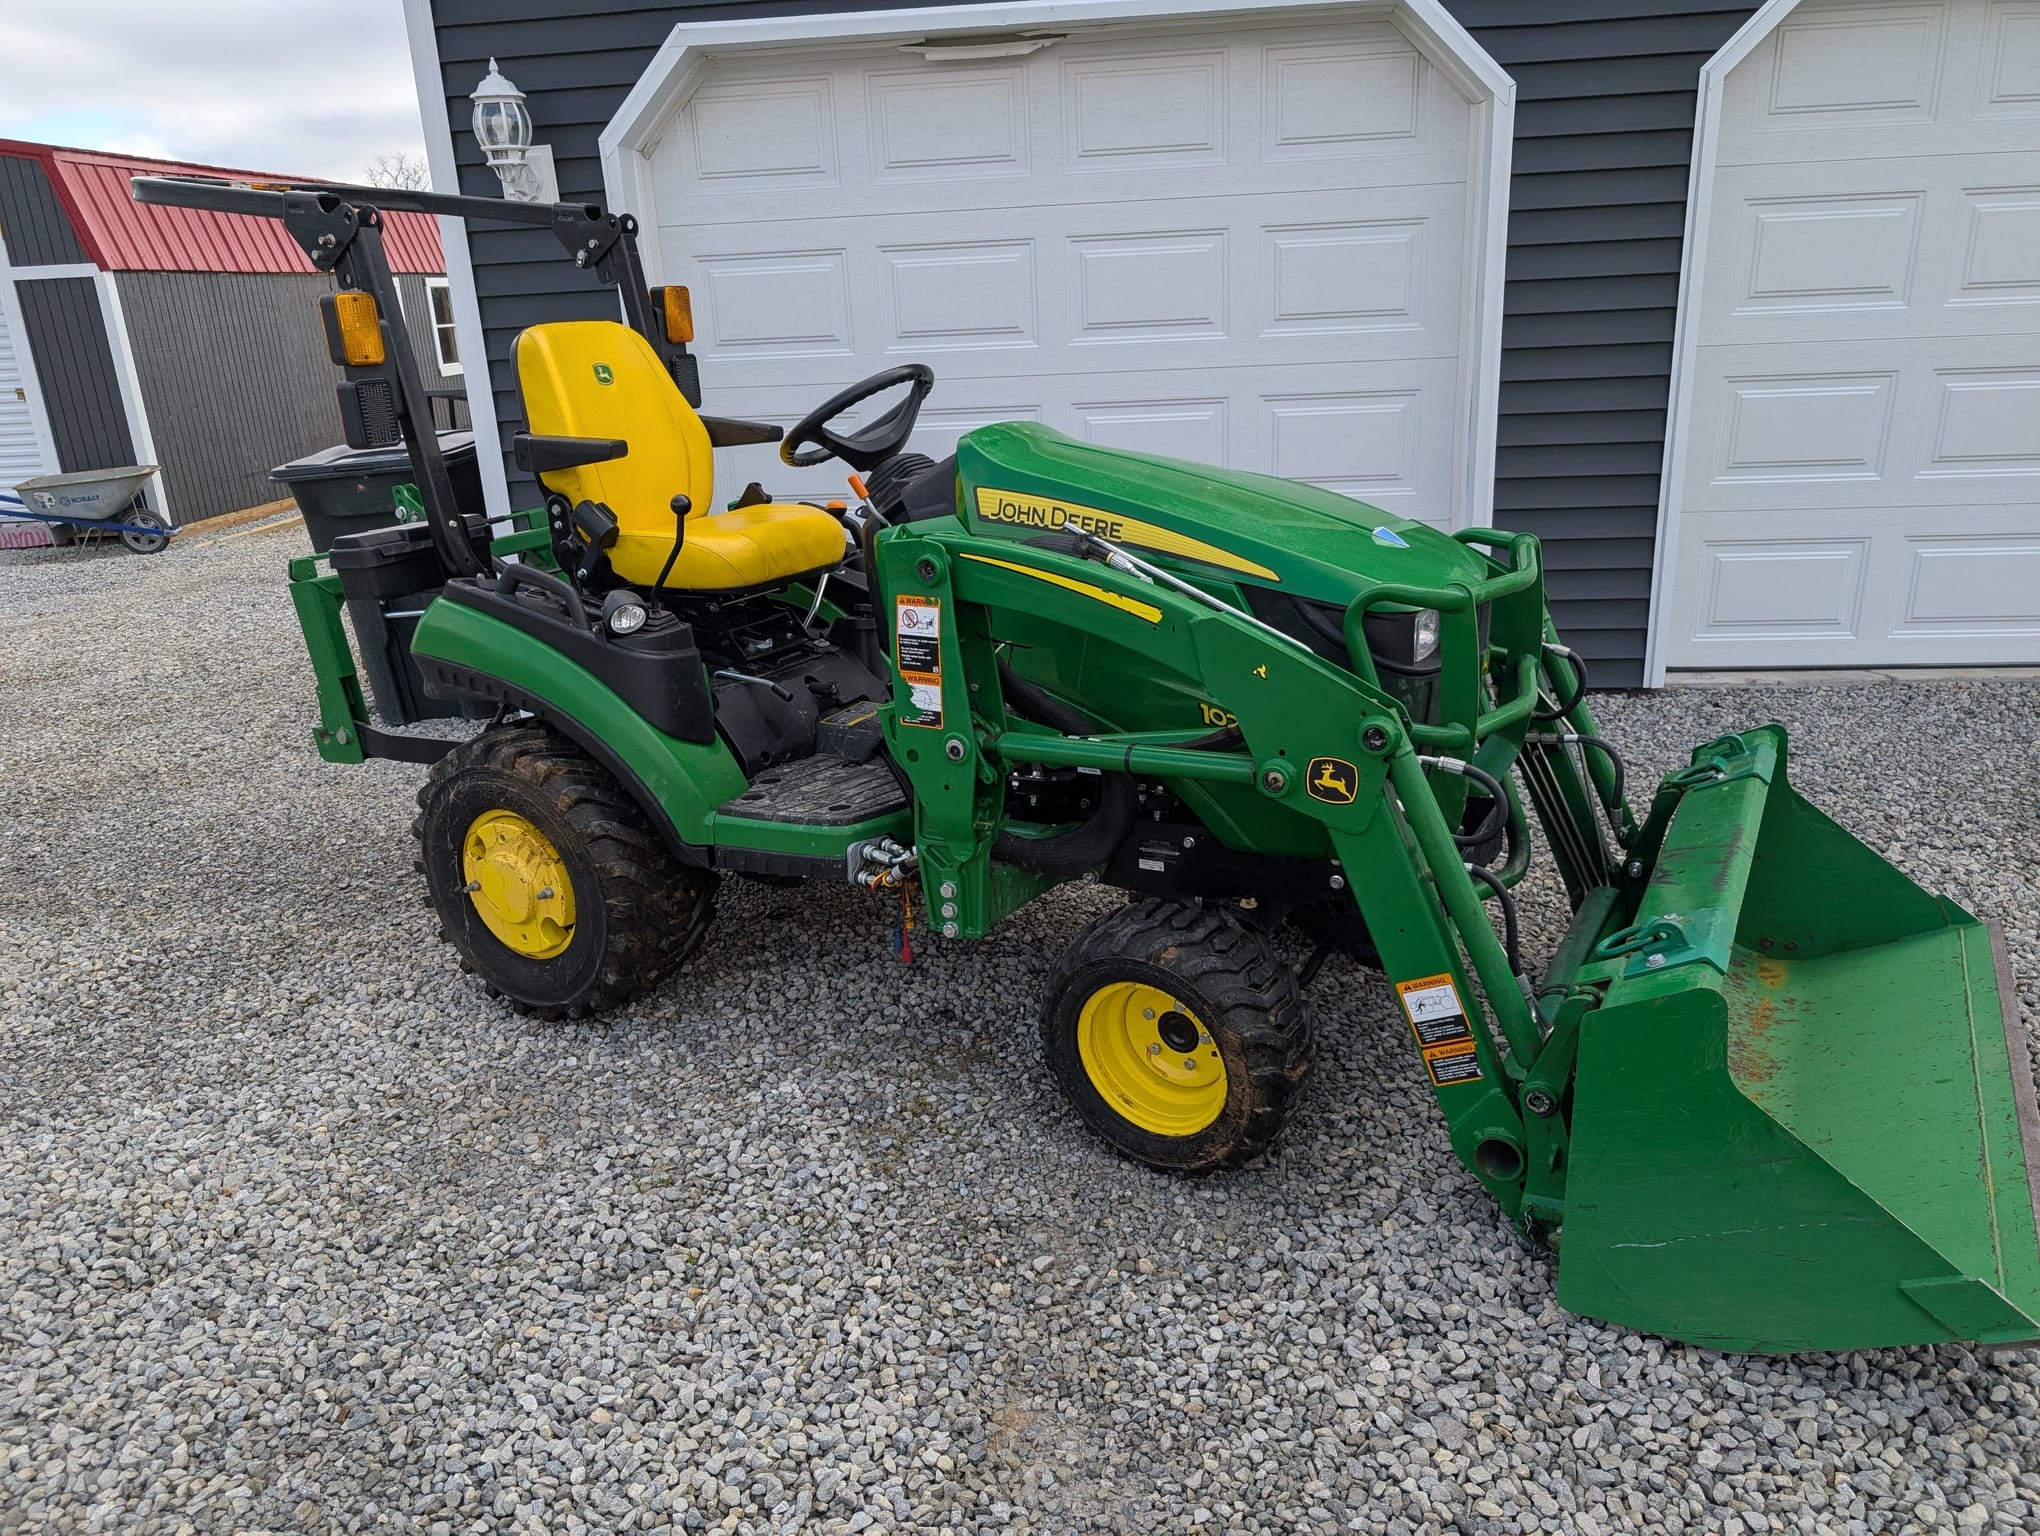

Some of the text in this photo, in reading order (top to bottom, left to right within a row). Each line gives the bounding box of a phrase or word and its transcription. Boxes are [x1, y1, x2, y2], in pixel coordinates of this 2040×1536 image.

[991, 498, 1123, 540] JOHN DEERE
[908, 675, 940, 685] WARNING
[1413, 977, 1446, 989] WARNING
[1439, 1045, 1473, 1057] WARNING
